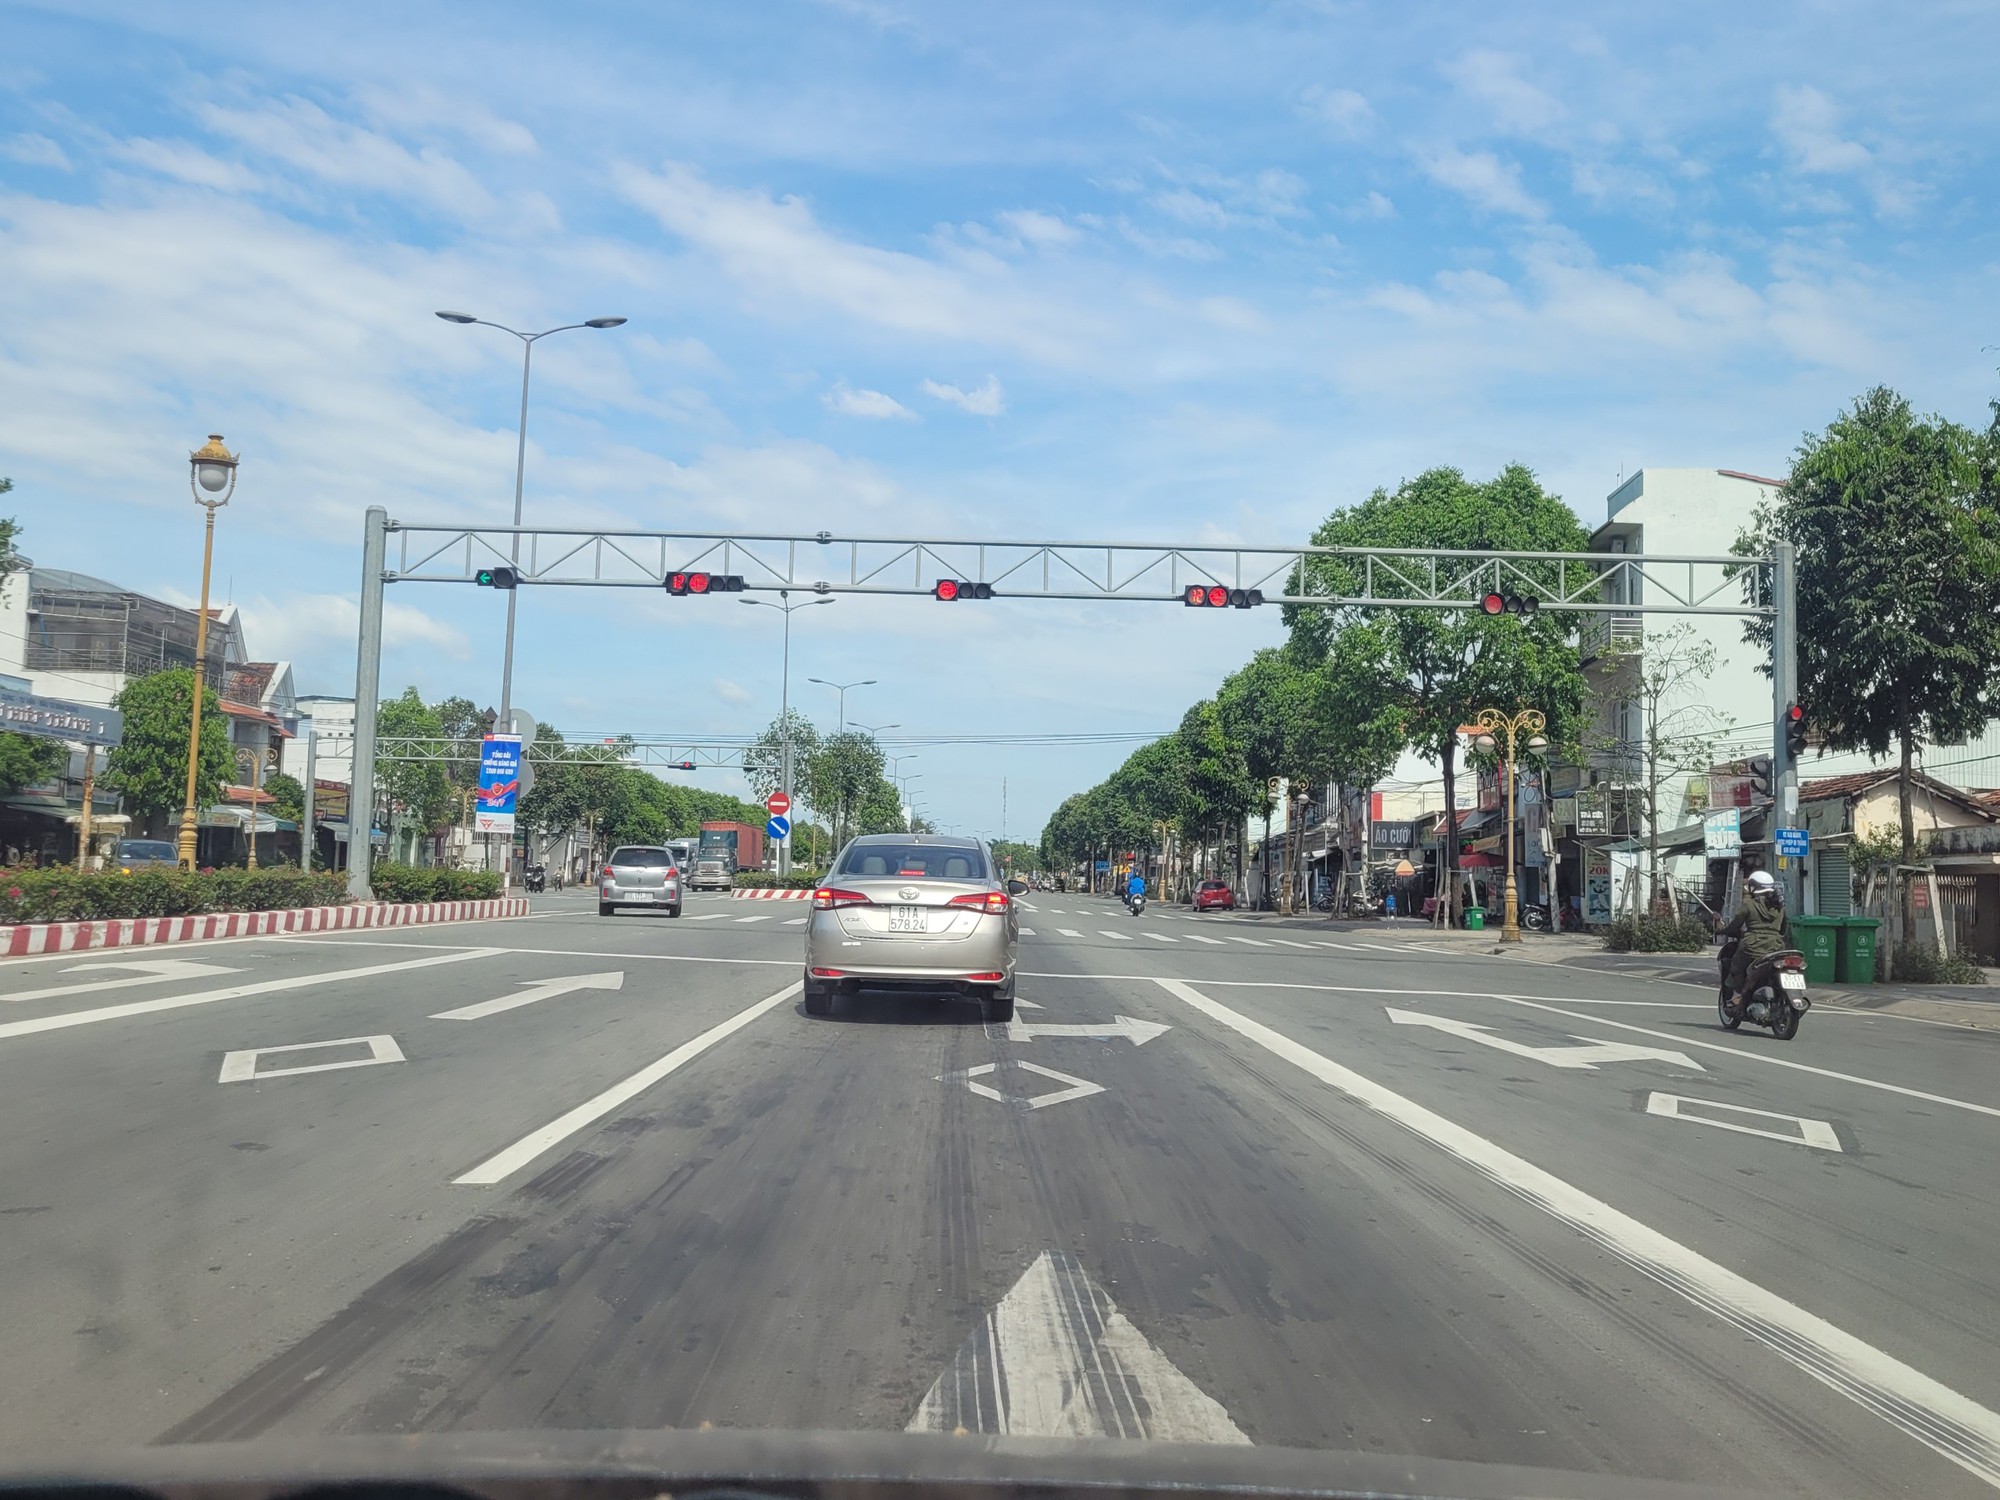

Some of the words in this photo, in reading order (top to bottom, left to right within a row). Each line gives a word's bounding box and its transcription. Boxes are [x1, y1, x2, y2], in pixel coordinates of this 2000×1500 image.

[672, 574, 685, 589] 12
[1192, 589, 1204, 604] 12
[1375, 826, 1387, 843] ÁO
[898, 907, 918, 918] 61A
[890, 919, 925, 931] 578.24
